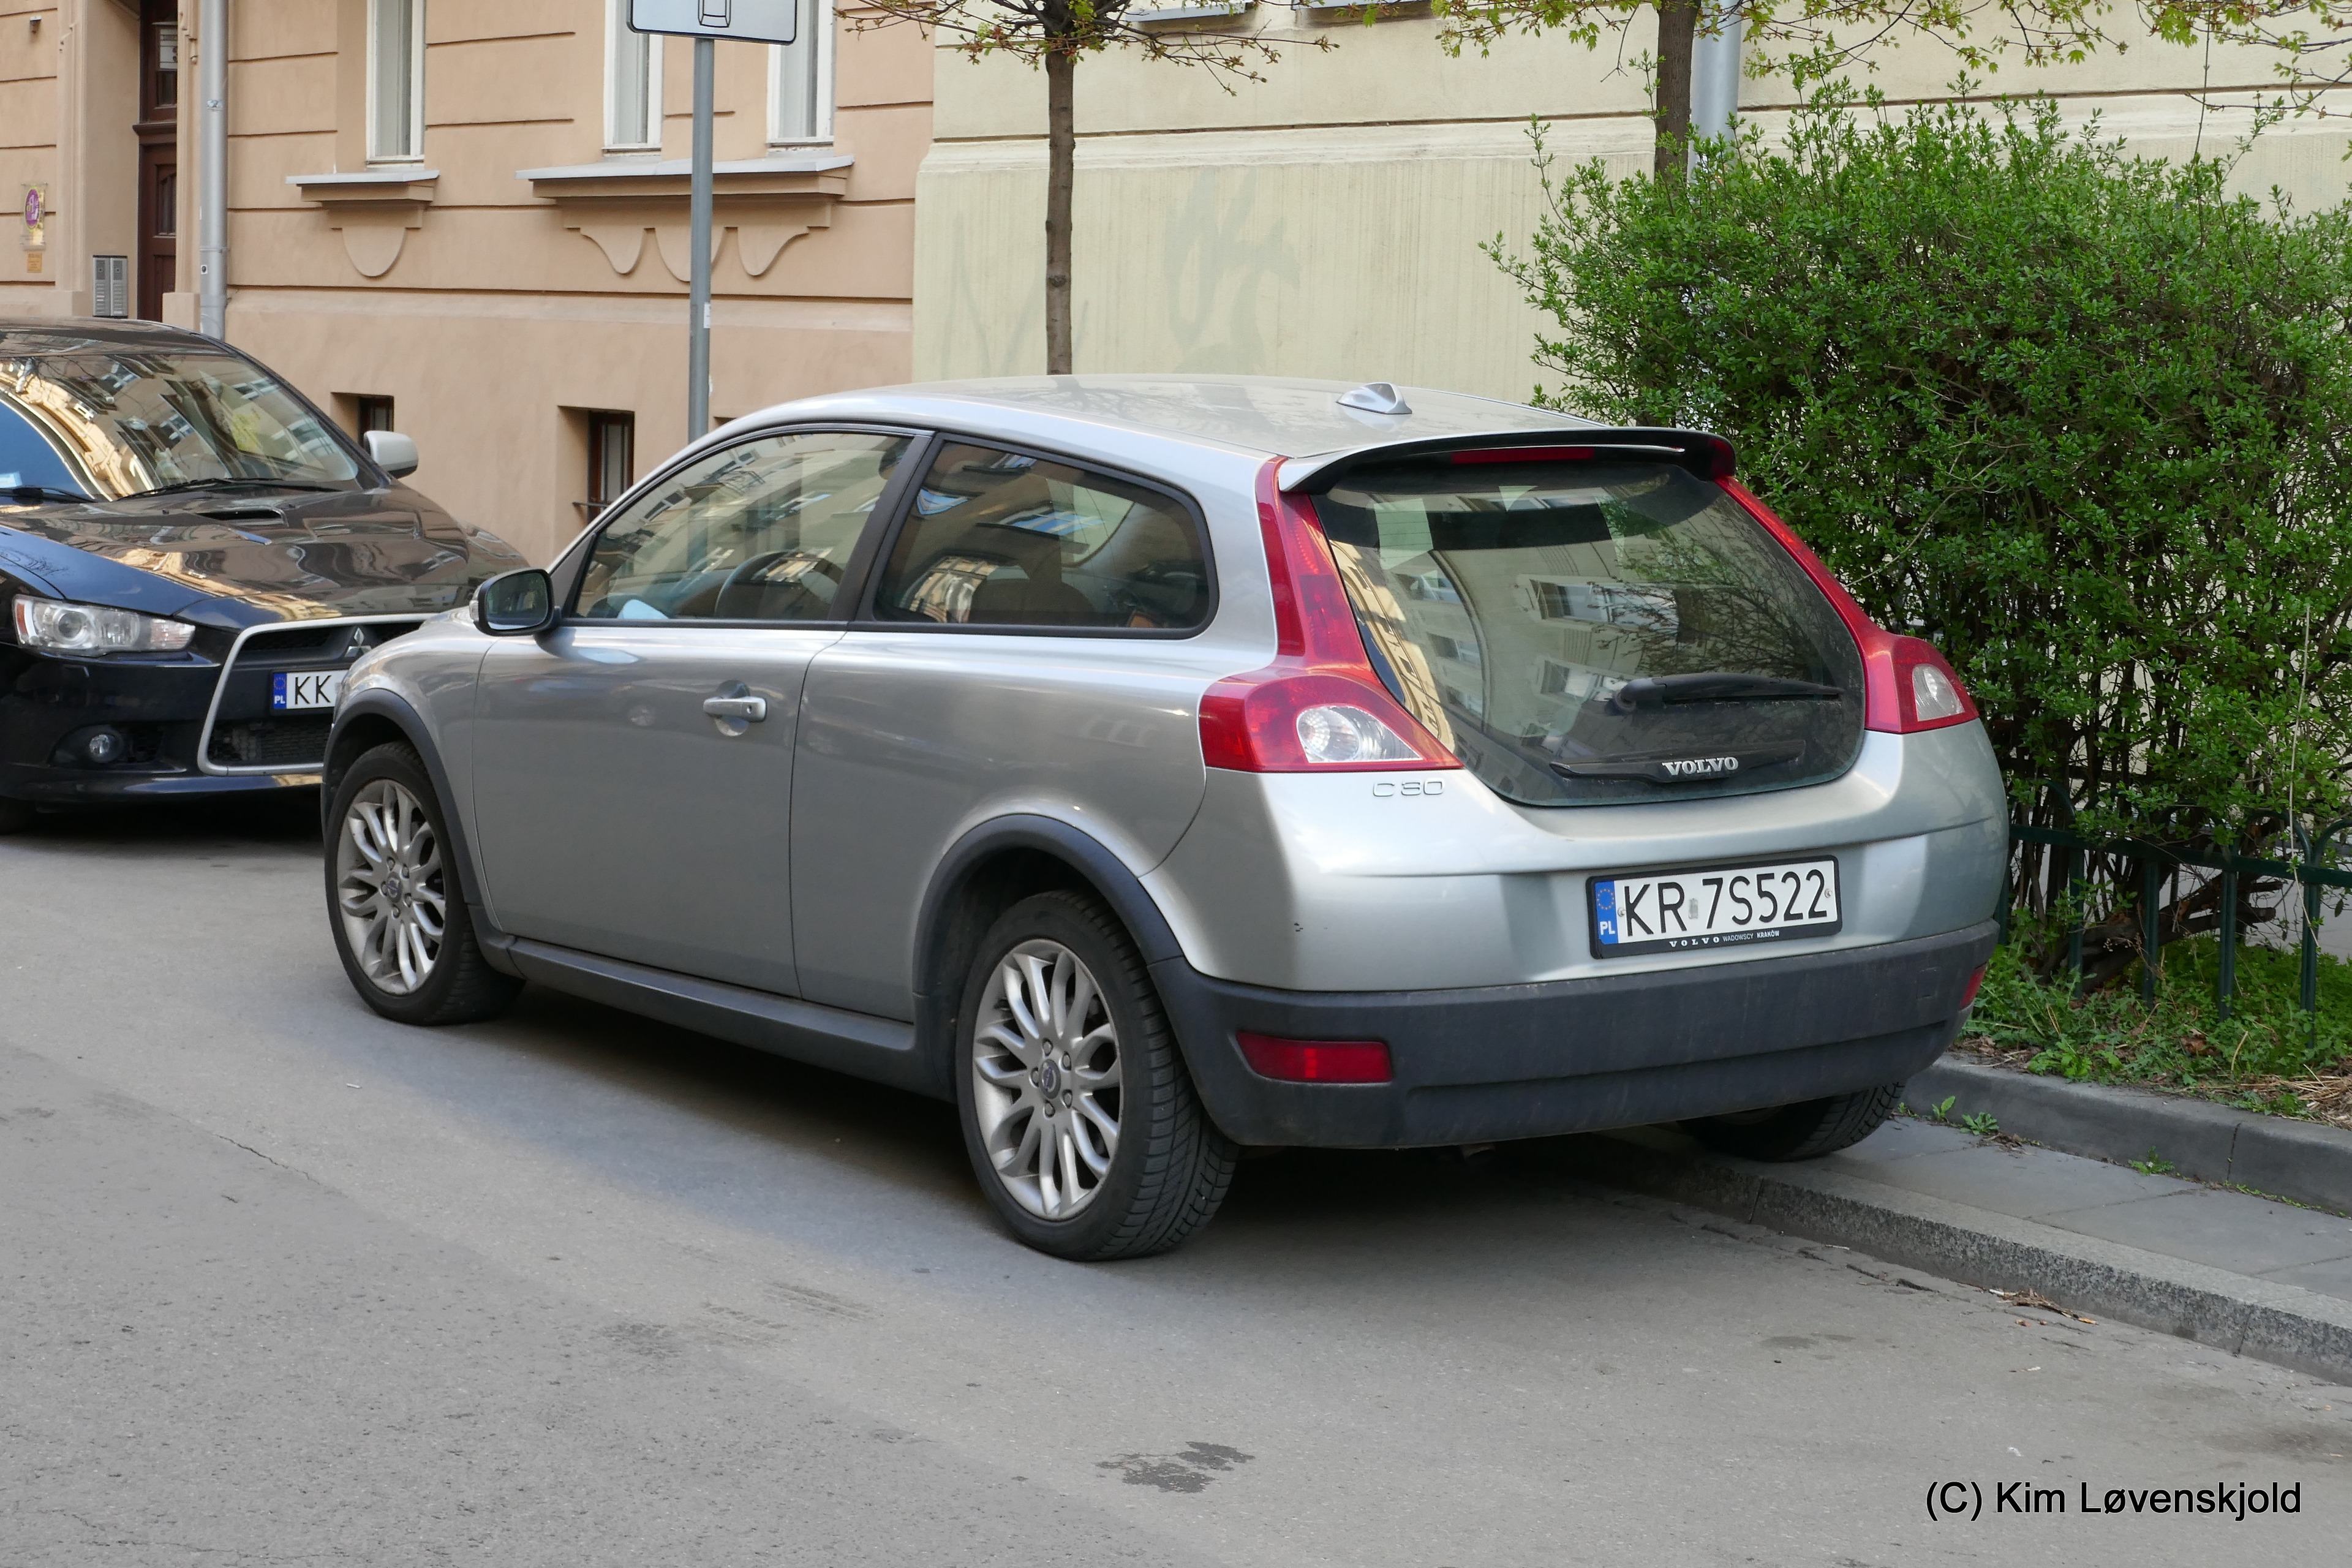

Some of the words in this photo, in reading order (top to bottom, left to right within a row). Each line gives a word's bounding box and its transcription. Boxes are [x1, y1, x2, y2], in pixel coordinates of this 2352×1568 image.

[274, 695, 285, 704] PL
[295, 675, 331, 704] KK
[1662, 756, 1740, 777] VOLVO
[1624, 881, 1687, 937] KR
[1702, 869, 1828, 929] 7S522
[1599, 921, 1616, 936] PL
[1669, 937, 1720, 948] VOLVO
[1722, 933, 1754, 942] WADOWSCY
[1757, 929, 1780, 938] KRAKÓW
